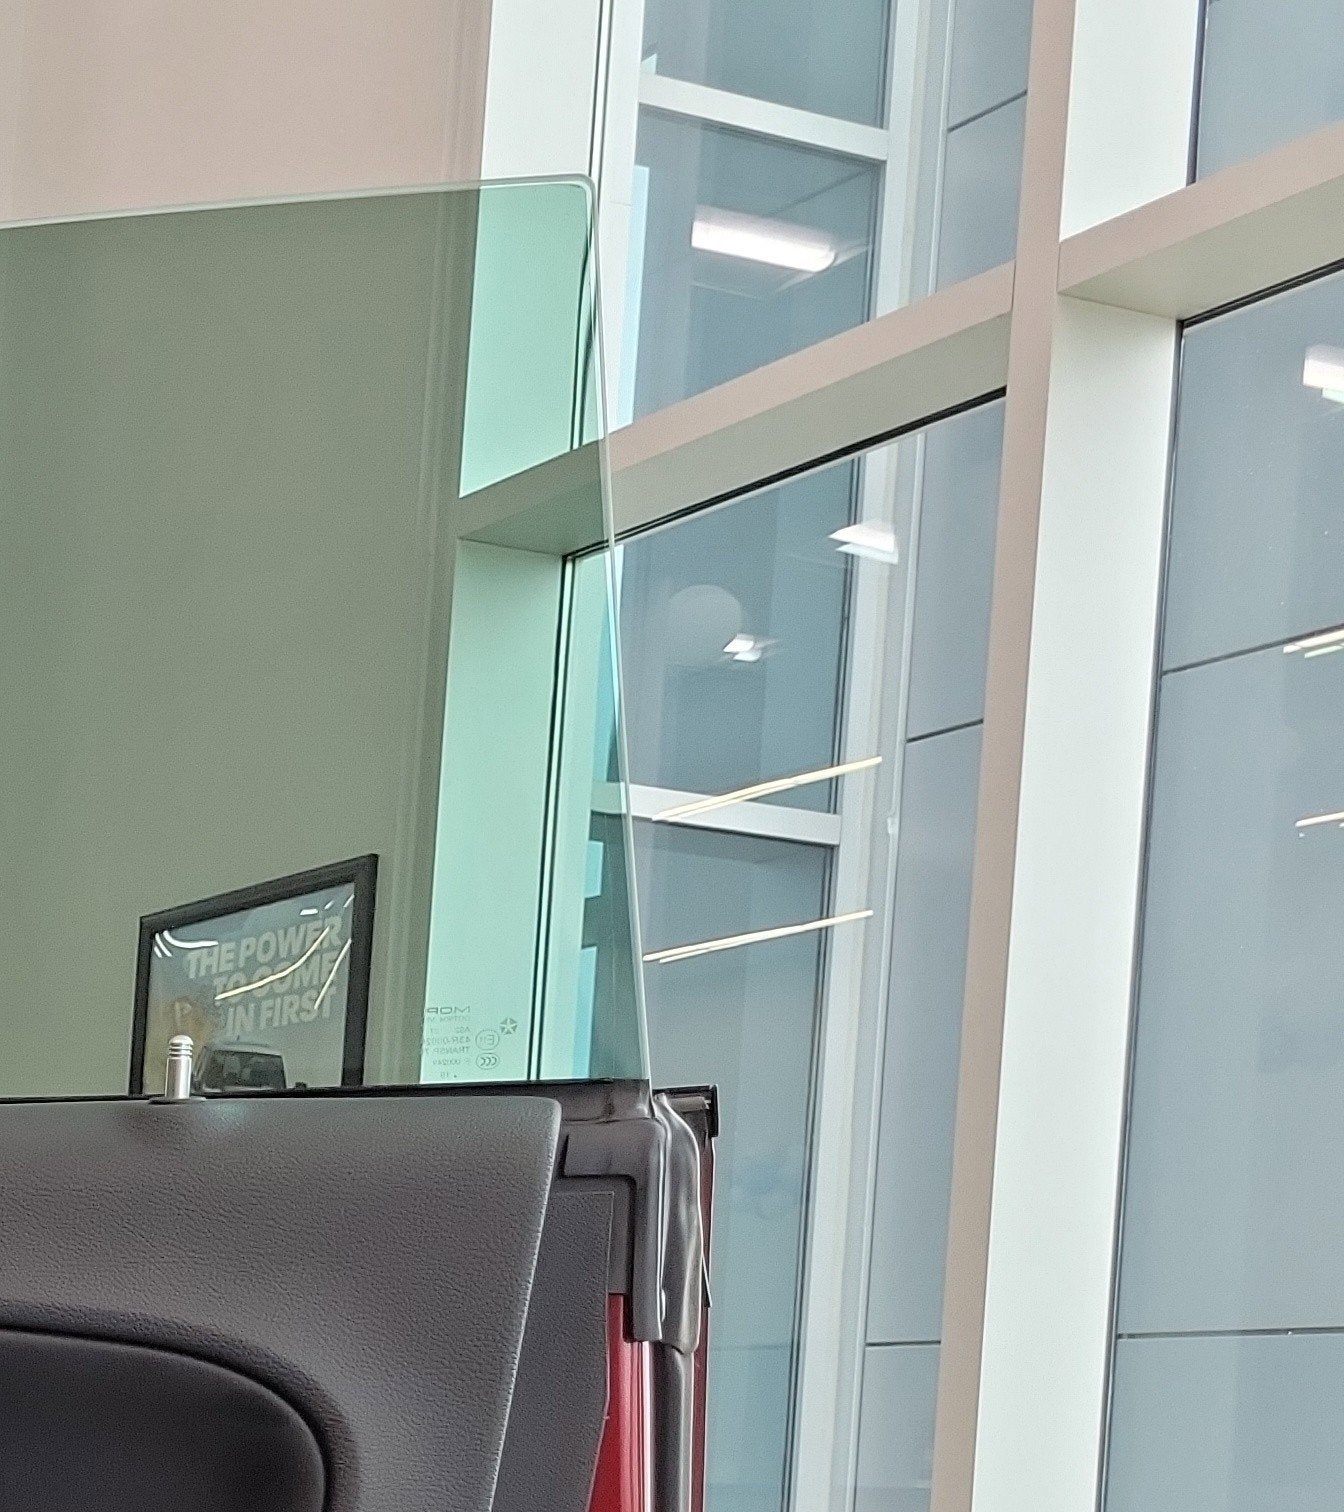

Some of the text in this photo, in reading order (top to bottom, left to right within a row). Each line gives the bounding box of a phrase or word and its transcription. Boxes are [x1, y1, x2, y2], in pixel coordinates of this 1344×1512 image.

[186, 916, 342, 978] THE POWER
[214, 951, 339, 1003] TO COME
[225, 1003, 256, 1037] IN
[261, 987, 337, 1029] FIRST
